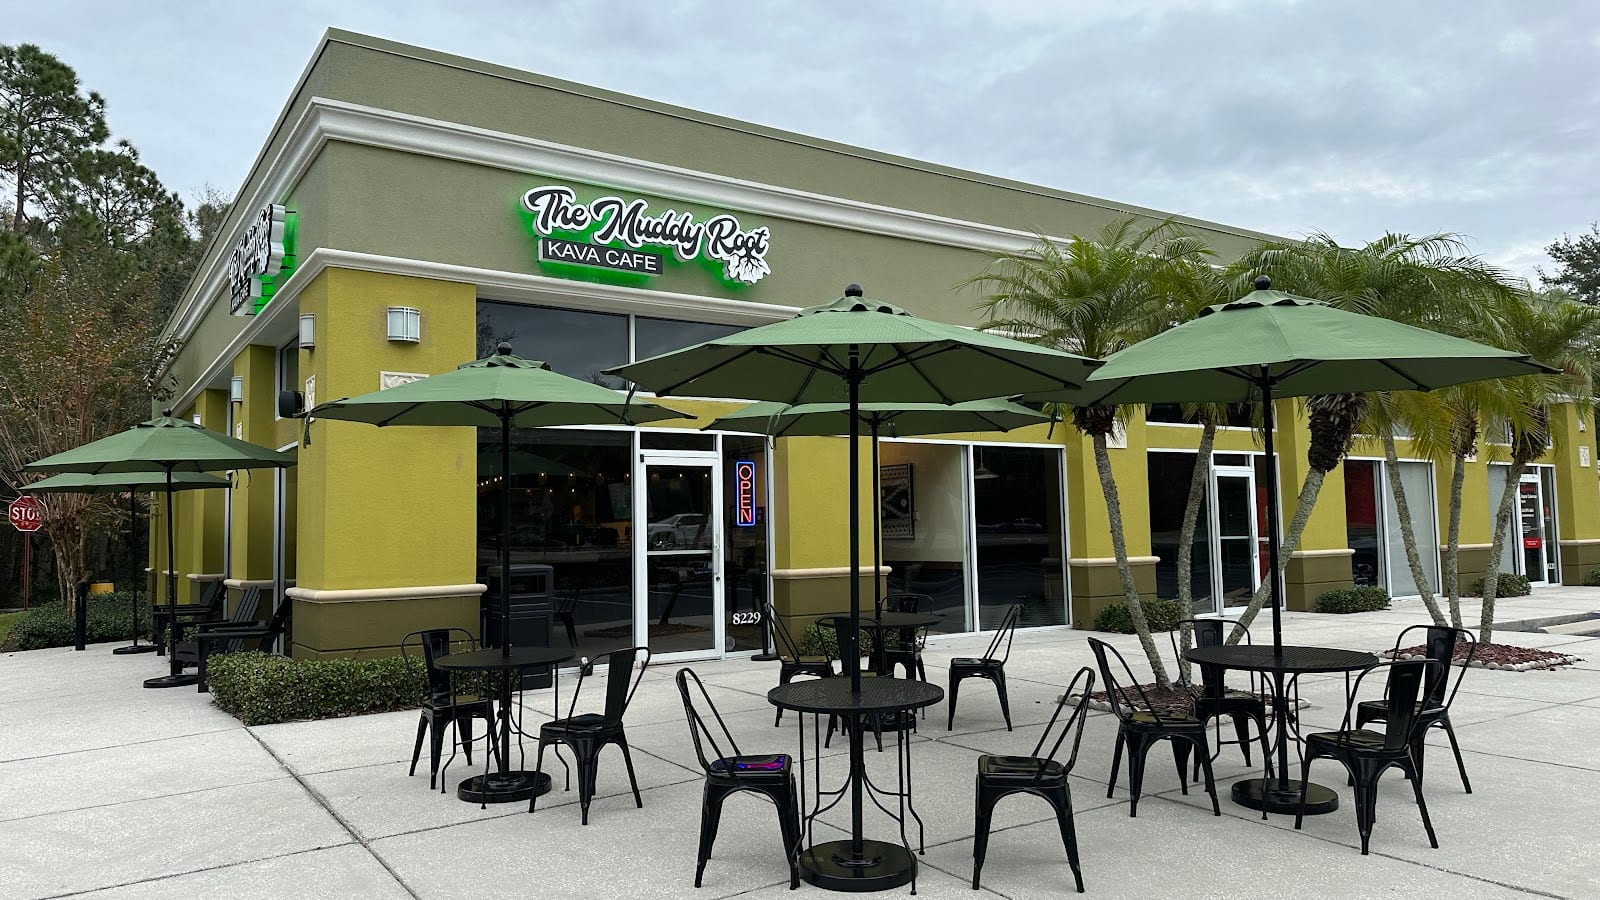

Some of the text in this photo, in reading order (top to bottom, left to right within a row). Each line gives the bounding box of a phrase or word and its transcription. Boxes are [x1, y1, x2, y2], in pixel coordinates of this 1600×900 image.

[526, 188, 768, 258] The Muddy Root
[548, 241, 657, 271] KAVA CAFE
[738, 465, 752, 523] OPEN
[12, 507, 41, 520] STO
[732, 612, 761, 625] 8229
